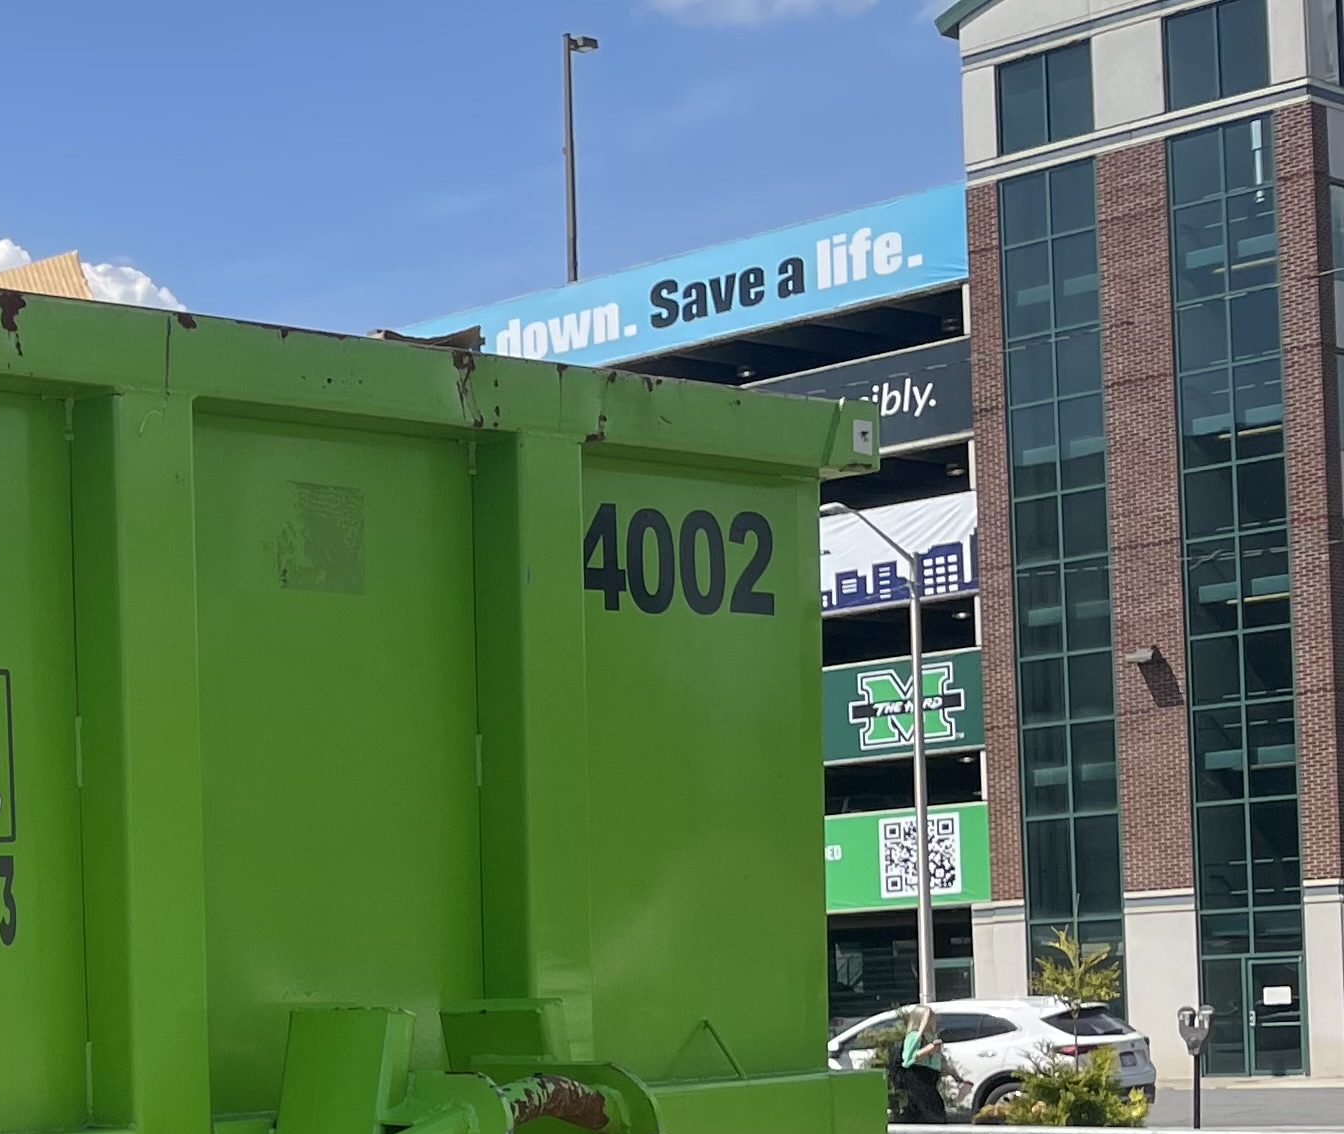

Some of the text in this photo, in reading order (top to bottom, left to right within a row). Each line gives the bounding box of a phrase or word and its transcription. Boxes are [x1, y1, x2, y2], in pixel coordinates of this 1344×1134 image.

[496, 227, 922, 360] down. Save a life.
[858, 378, 937, 417] ibly.
[584, 503, 775, 616] 4002
[873, 697, 943, 717] THE HRD
